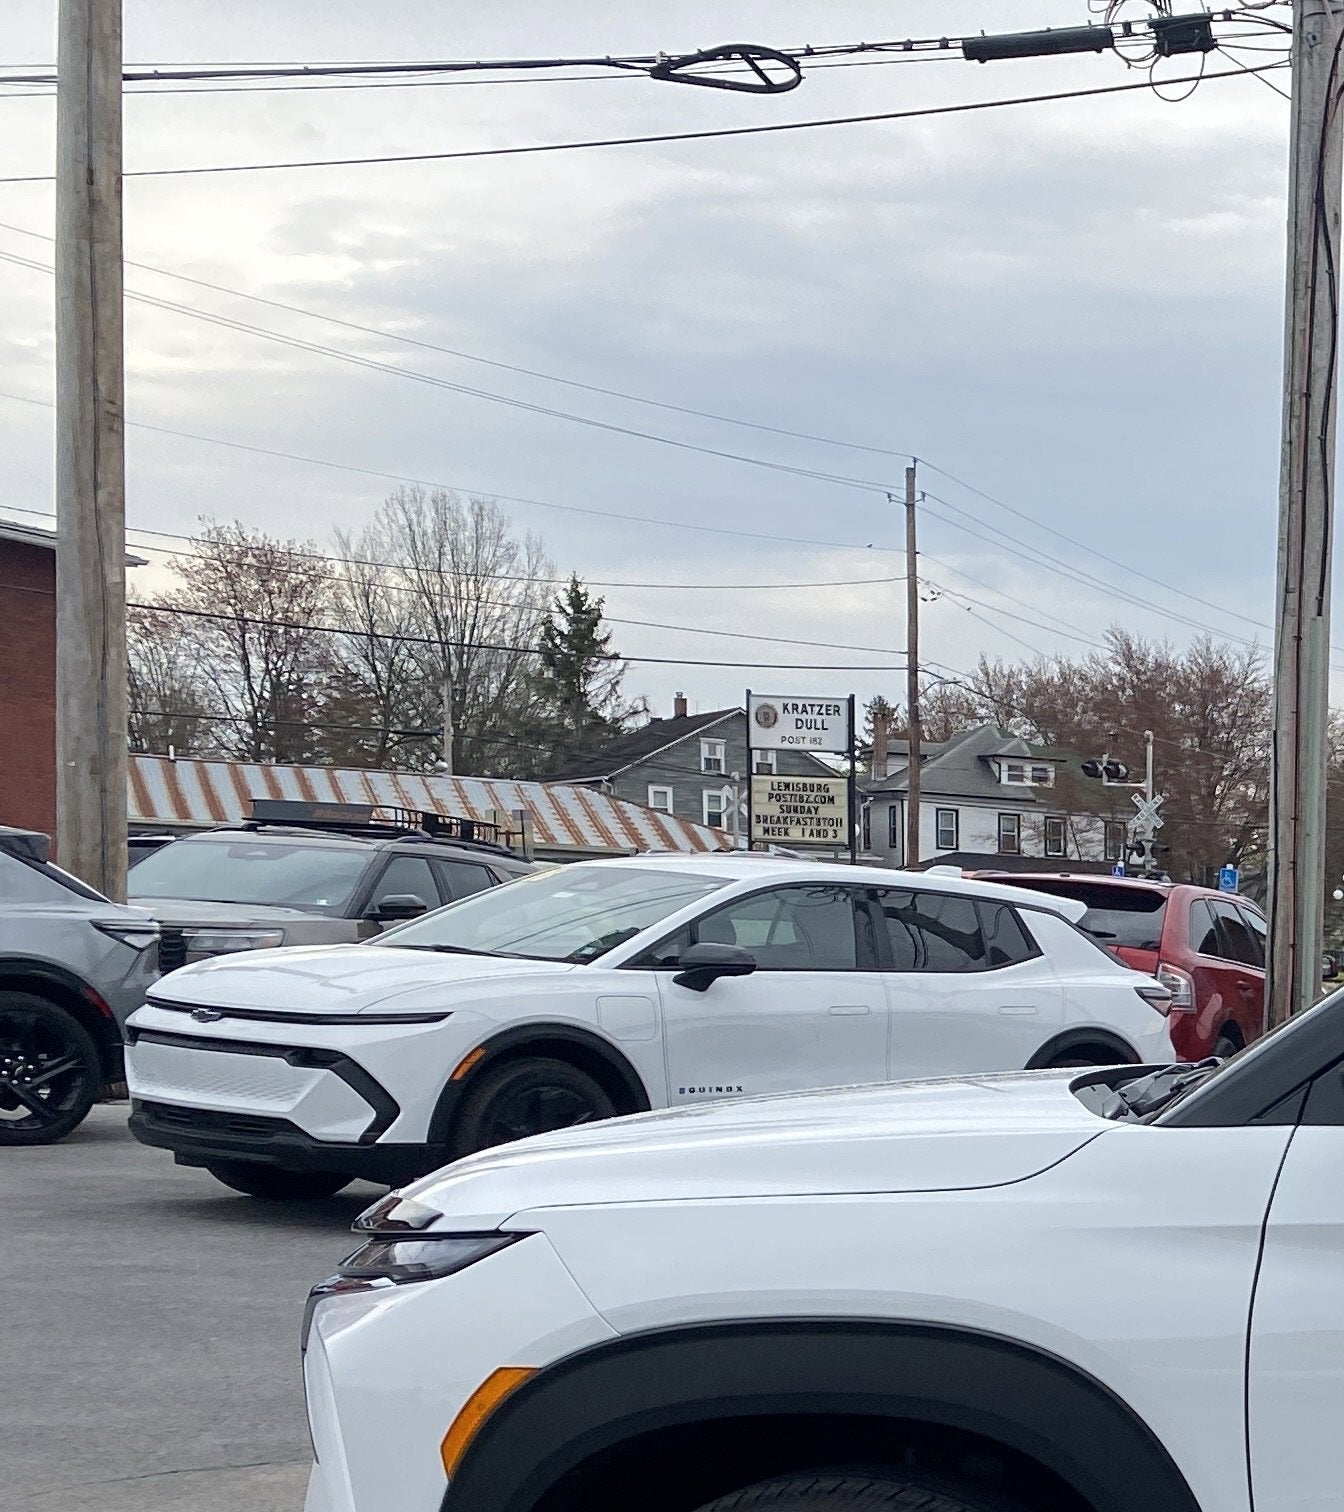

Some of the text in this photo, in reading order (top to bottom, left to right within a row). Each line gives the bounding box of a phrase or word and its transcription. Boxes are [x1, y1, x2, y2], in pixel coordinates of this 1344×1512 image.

[782, 702, 841, 716] KRATZER
[795, 717, 829, 731] DULL
[780, 735, 807, 744] POST
[770, 781, 830, 793] LEWISBURG
[779, 804, 820, 815] SUNDAY
[762, 826, 790, 837] WEEK
[808, 828, 829, 838] AND
[831, 829, 838, 839] 3
[678, 1085, 743, 1095] EQUINOX
